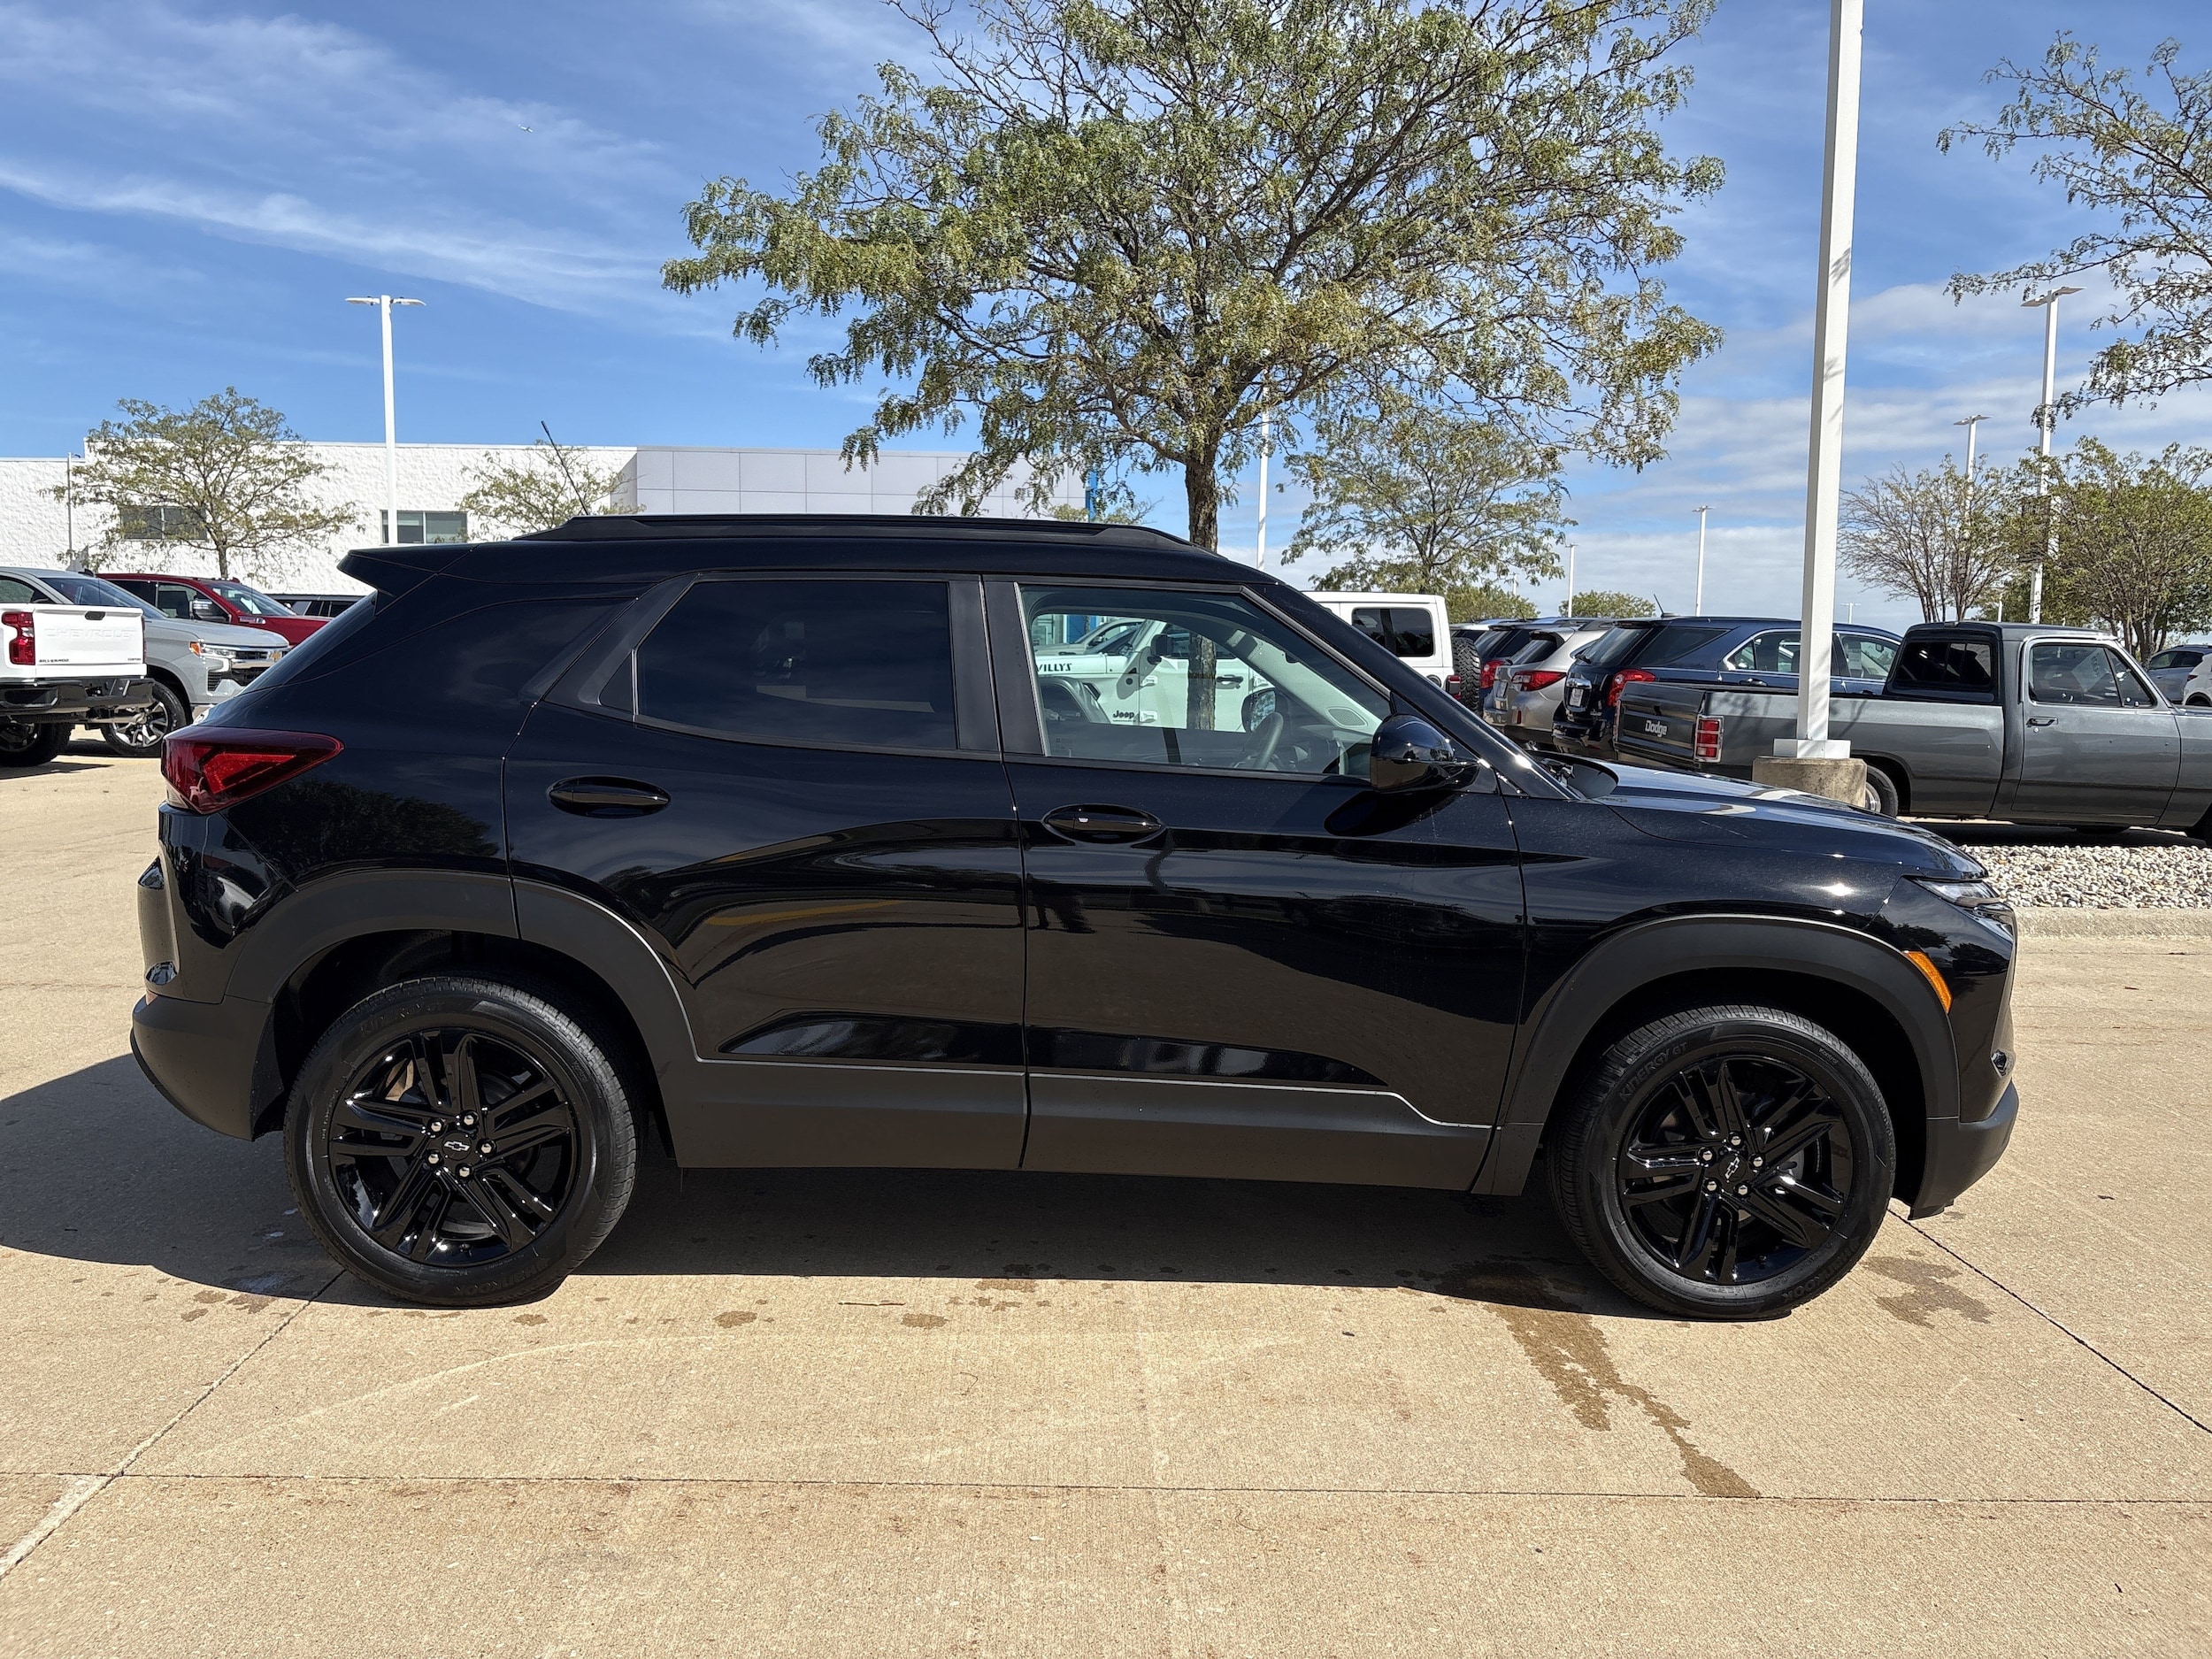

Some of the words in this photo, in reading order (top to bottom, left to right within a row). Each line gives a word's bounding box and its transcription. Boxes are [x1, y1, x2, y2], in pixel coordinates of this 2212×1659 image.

[1039, 663, 1072, 672] ILLYS
[1112, 710, 1135, 719] Jeep
[1645, 719, 1668, 738] Dodge
[1619, 1048, 1672, 1102] KINERGY
[1671, 1042, 1688, 1056] GT
